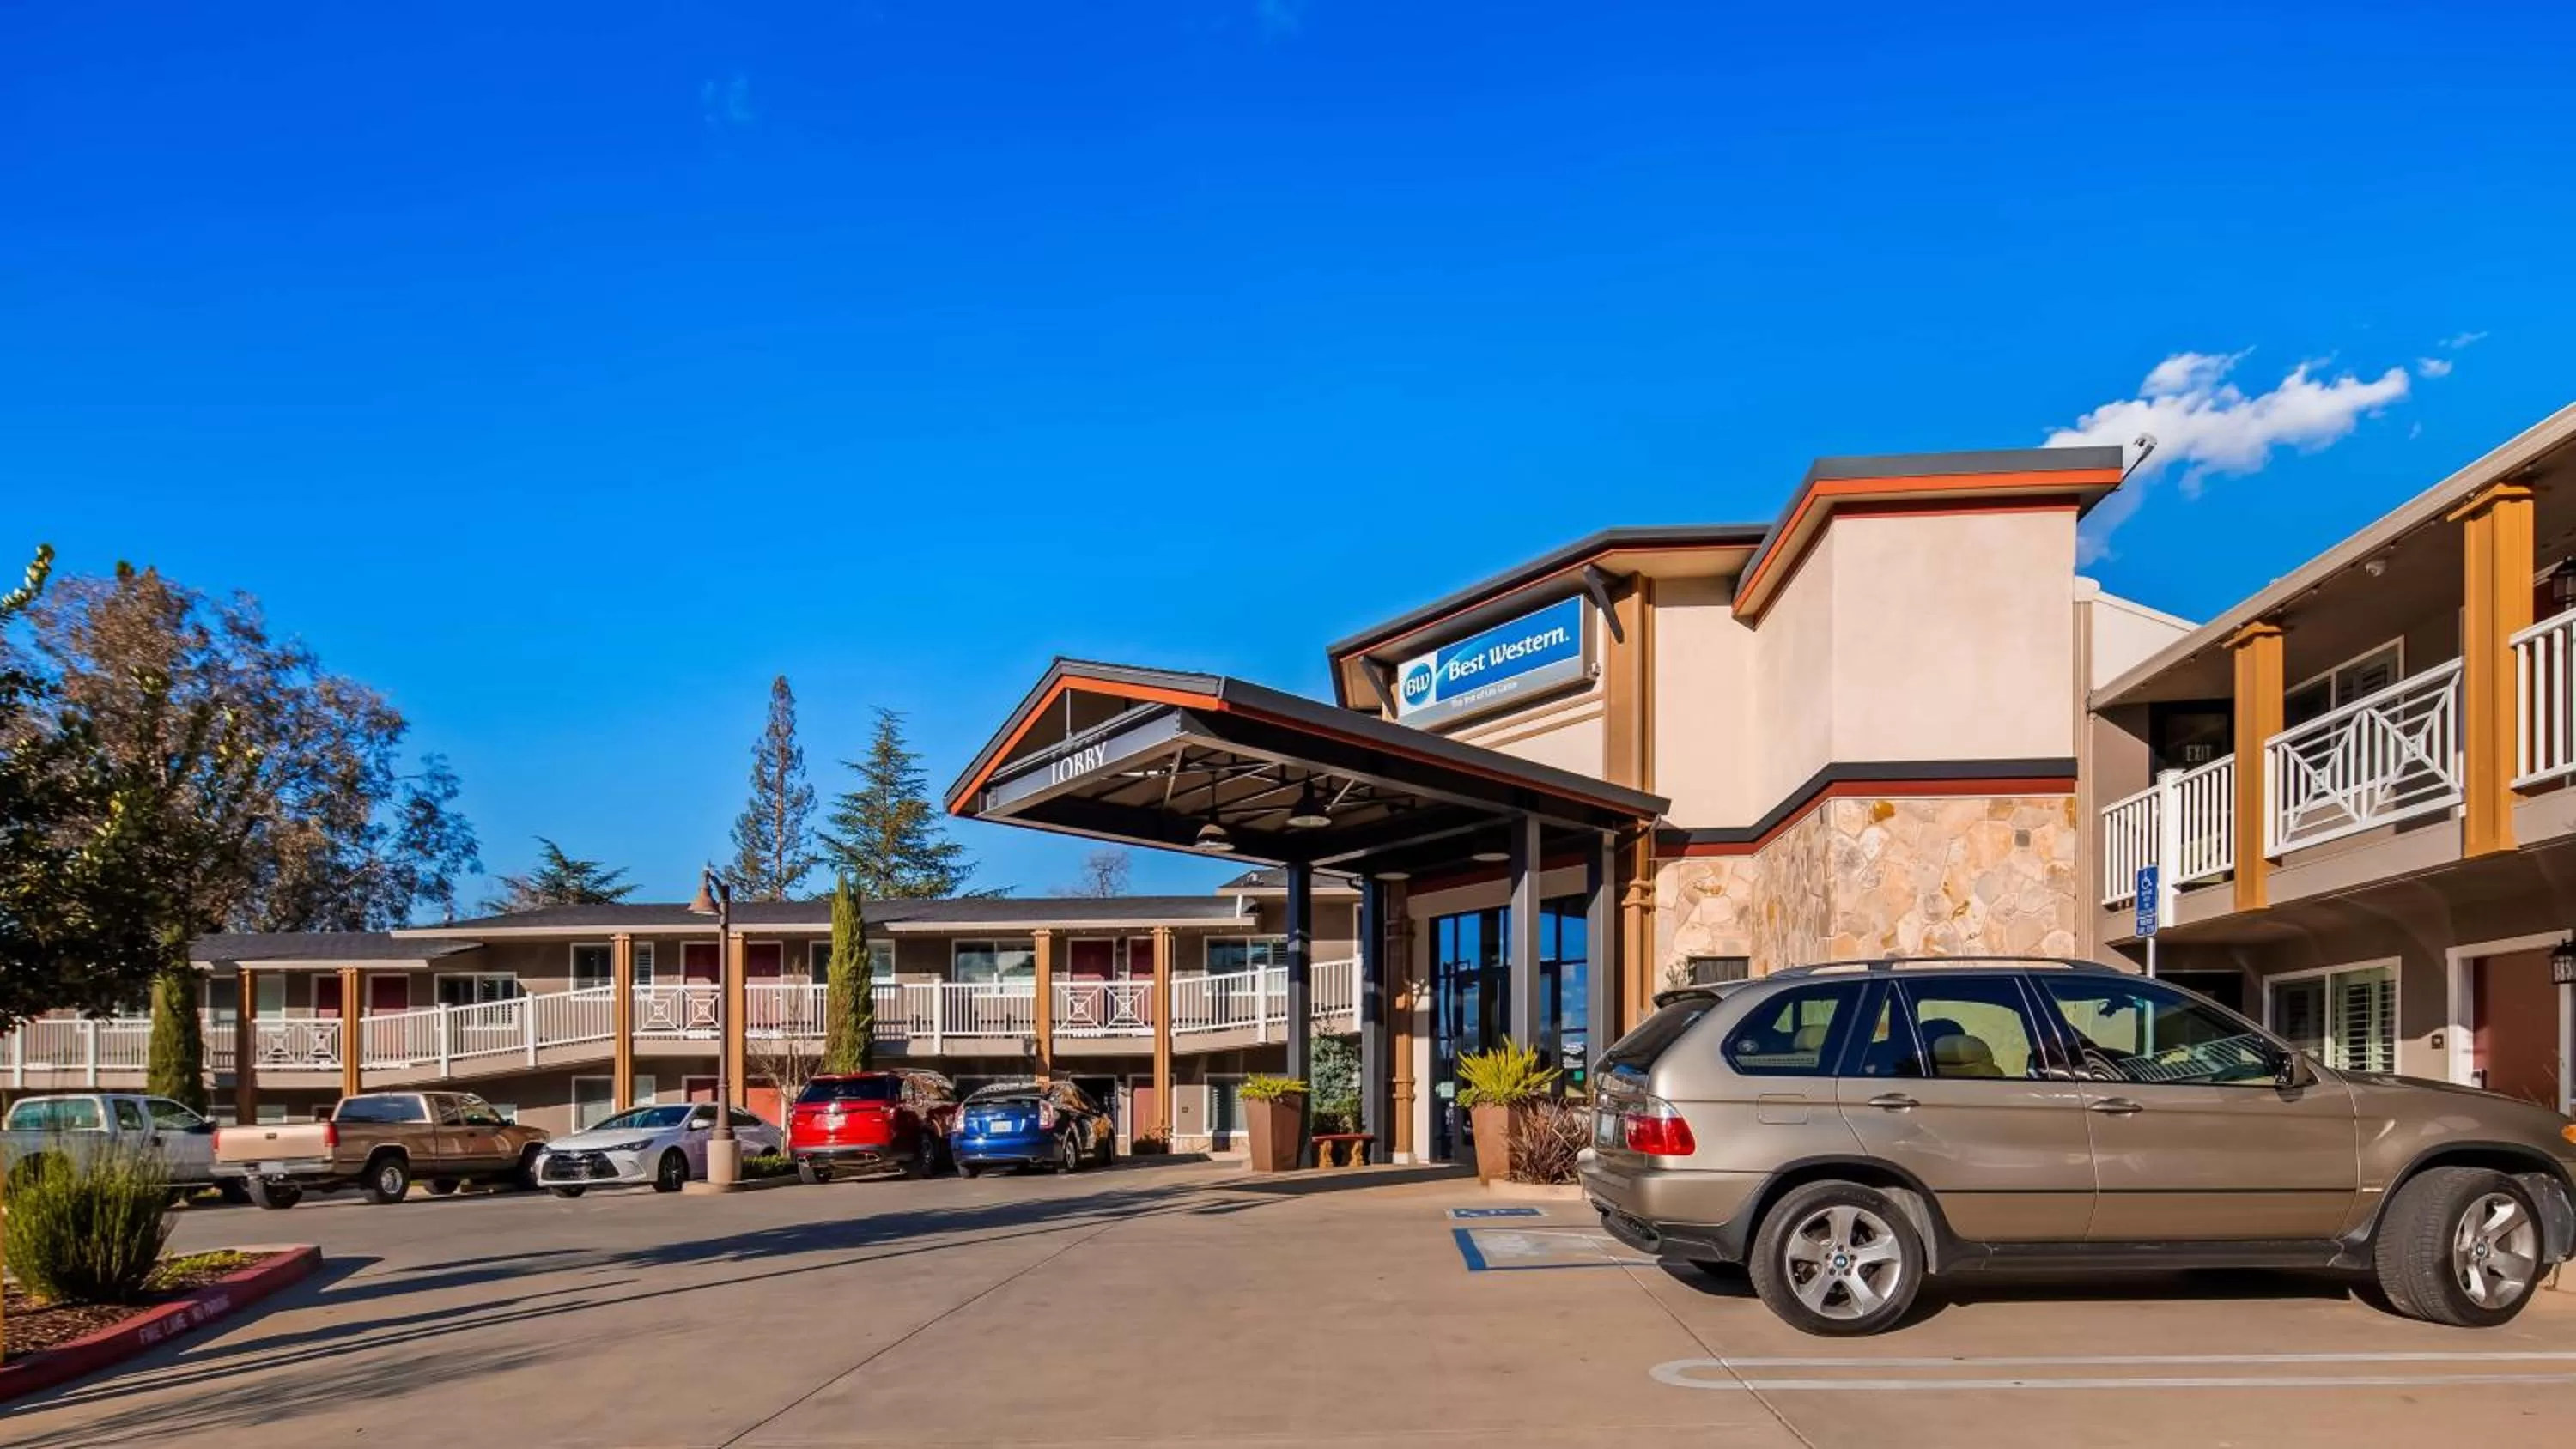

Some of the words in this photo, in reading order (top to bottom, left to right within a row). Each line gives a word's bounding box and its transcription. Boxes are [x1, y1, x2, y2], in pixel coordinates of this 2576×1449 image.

[1448, 653, 1486, 682] Best
[1406, 672, 1430, 697] BW
[1051, 741, 1107, 785] LOBBY
[2185, 743, 2212, 762] EXIT
